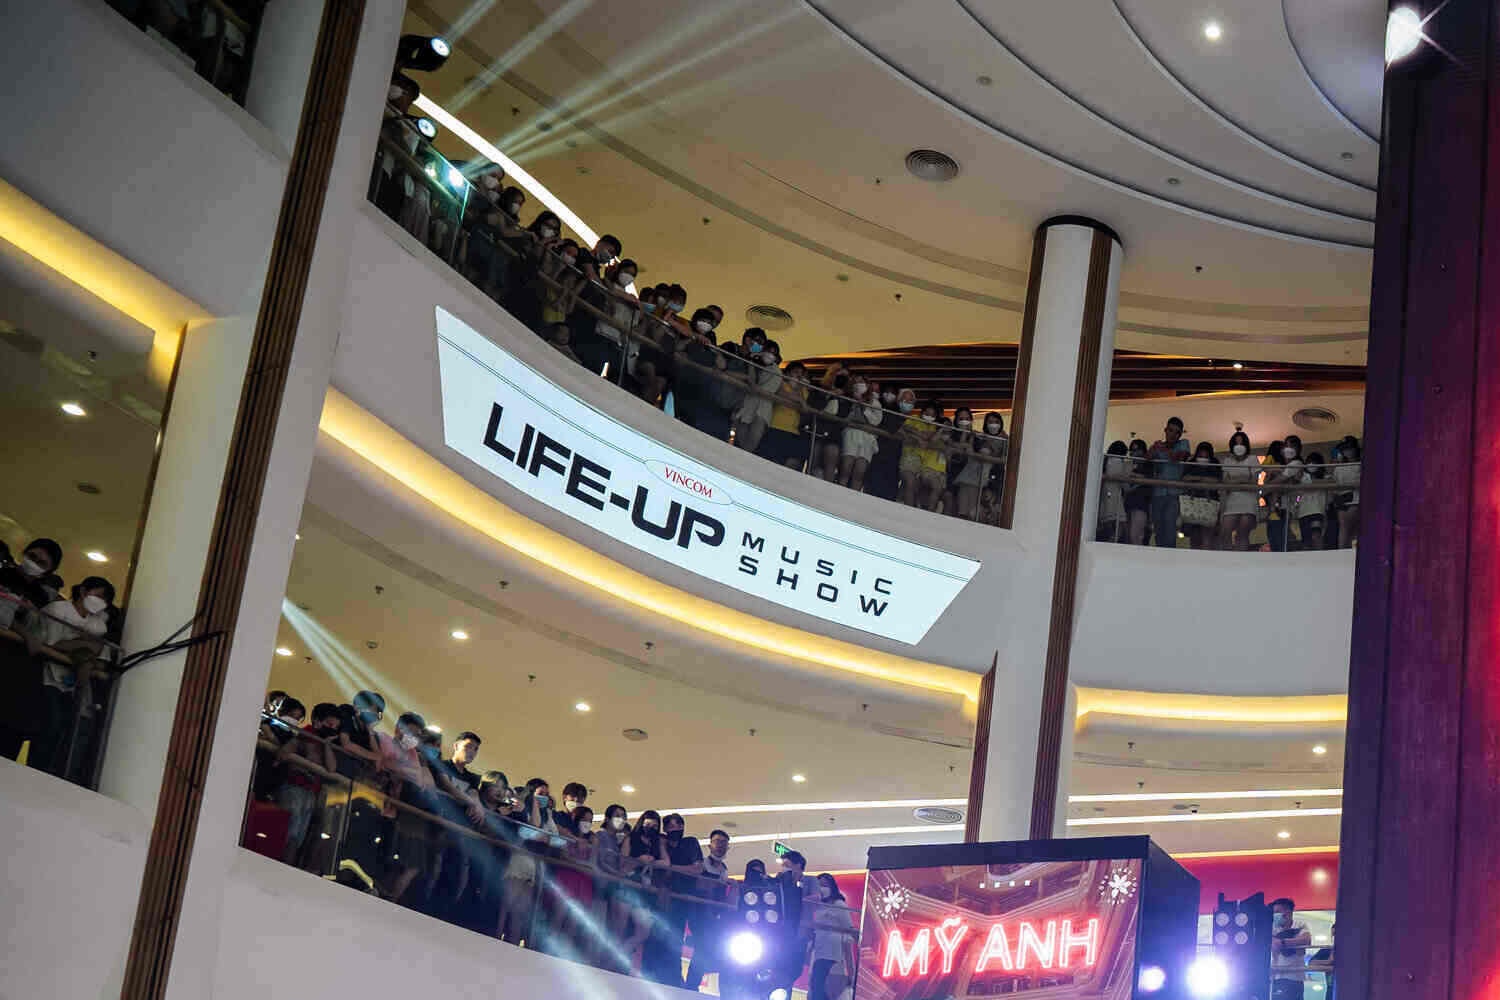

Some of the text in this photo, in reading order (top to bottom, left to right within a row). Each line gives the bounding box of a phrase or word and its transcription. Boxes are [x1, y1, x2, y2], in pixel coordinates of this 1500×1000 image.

[482, 401, 726, 549] LIFE-UP
[664, 465, 713, 499] VINCOM
[738, 554, 888, 617] SHOW
[740, 531, 894, 595] MUSIC
[883, 917, 1098, 977] MỸ ANH
